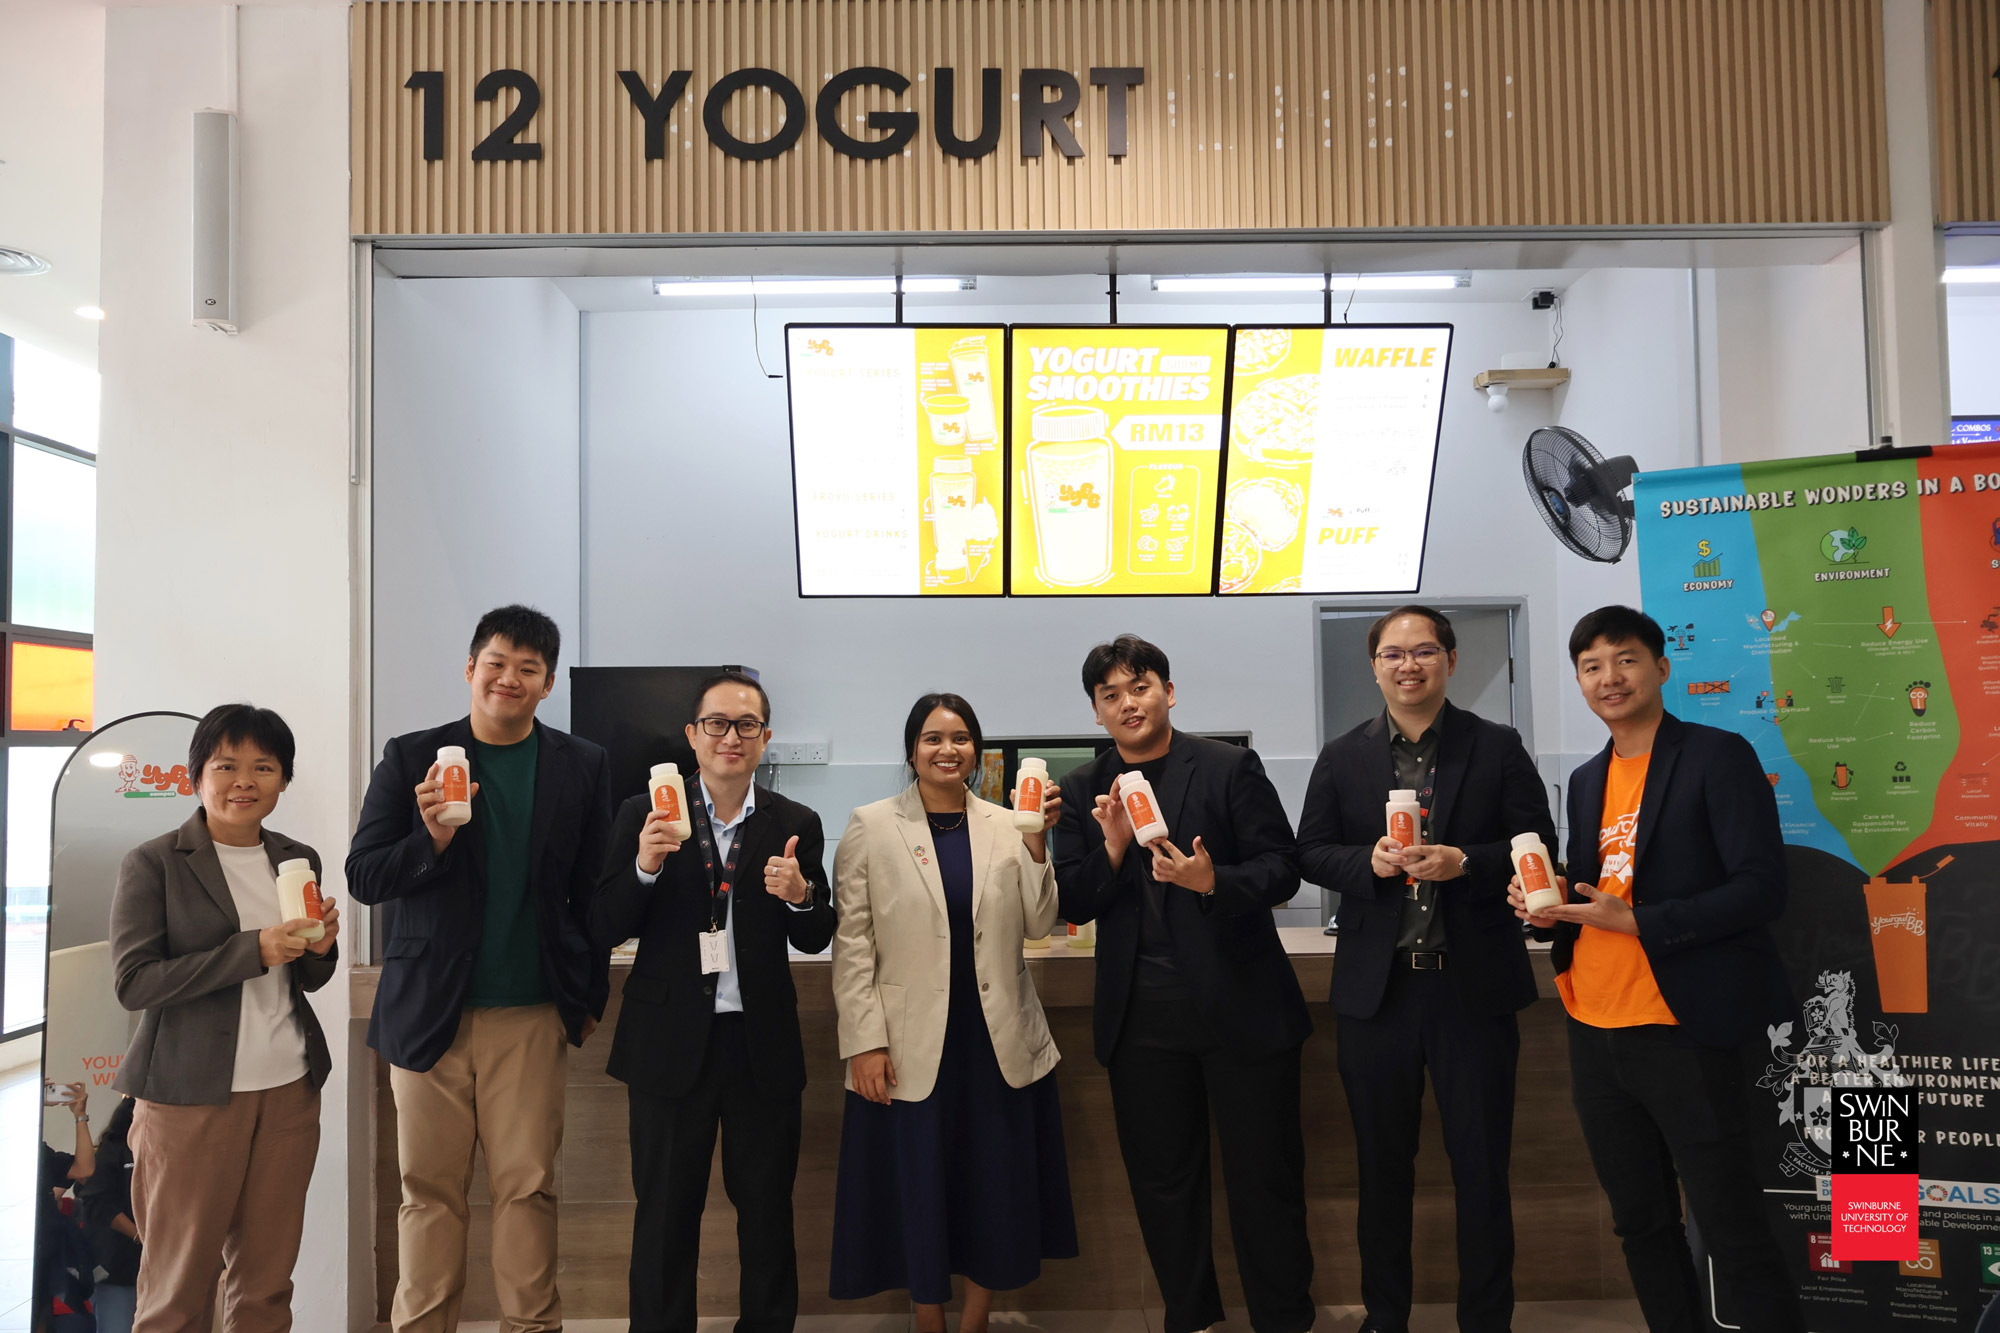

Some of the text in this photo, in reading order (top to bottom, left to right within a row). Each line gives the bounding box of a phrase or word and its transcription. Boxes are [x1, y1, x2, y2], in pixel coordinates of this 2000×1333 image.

[404, 66, 1145, 161] 12 YOGURT
[1028, 347, 1160, 374] YOGURT
[1334, 347, 1437, 368] WAFFLE
[1026, 375, 1212, 402] SMOOTHIES
[1130, 423, 1205, 443] RM13
[1956, 424, 1992, 432] COMBOS
[1660, 490, 1796, 519] SUSTAINABLE
[1804, 481, 1907, 506] WONDERS
[1917, 478, 1940, 496] IN
[1950, 476, 1965, 494] A
[1317, 526, 1380, 546] PUFF
[1814, 568, 1891, 582] ENVIRONMENT
[1683, 579, 1735, 592] ECONOMY
[1743, 641, 1793, 650] Manufacturing
[1888, 638, 1913, 647] Energy
[1954, 814, 1998, 822] Community
[1796, 1053, 1828, 1069] FOR
[1838, 1054, 1849, 1068] A
[1857, 1054, 1953, 1071] HEALTHIER
[1790, 1072, 1800, 1086] A
[1810, 1072, 1874, 1086] BETTER
[1918, 1091, 1985, 1108] FUTURE
[1789, 1212, 1811, 1221] with
[1922, 1210, 1941, 1219] and
[1943, 1211, 1981, 1221] policies
[1982, 1213, 1993, 1222] in
[1810, 1235, 1817, 1244] 8
[1982, 1245, 1993, 1256] 13
